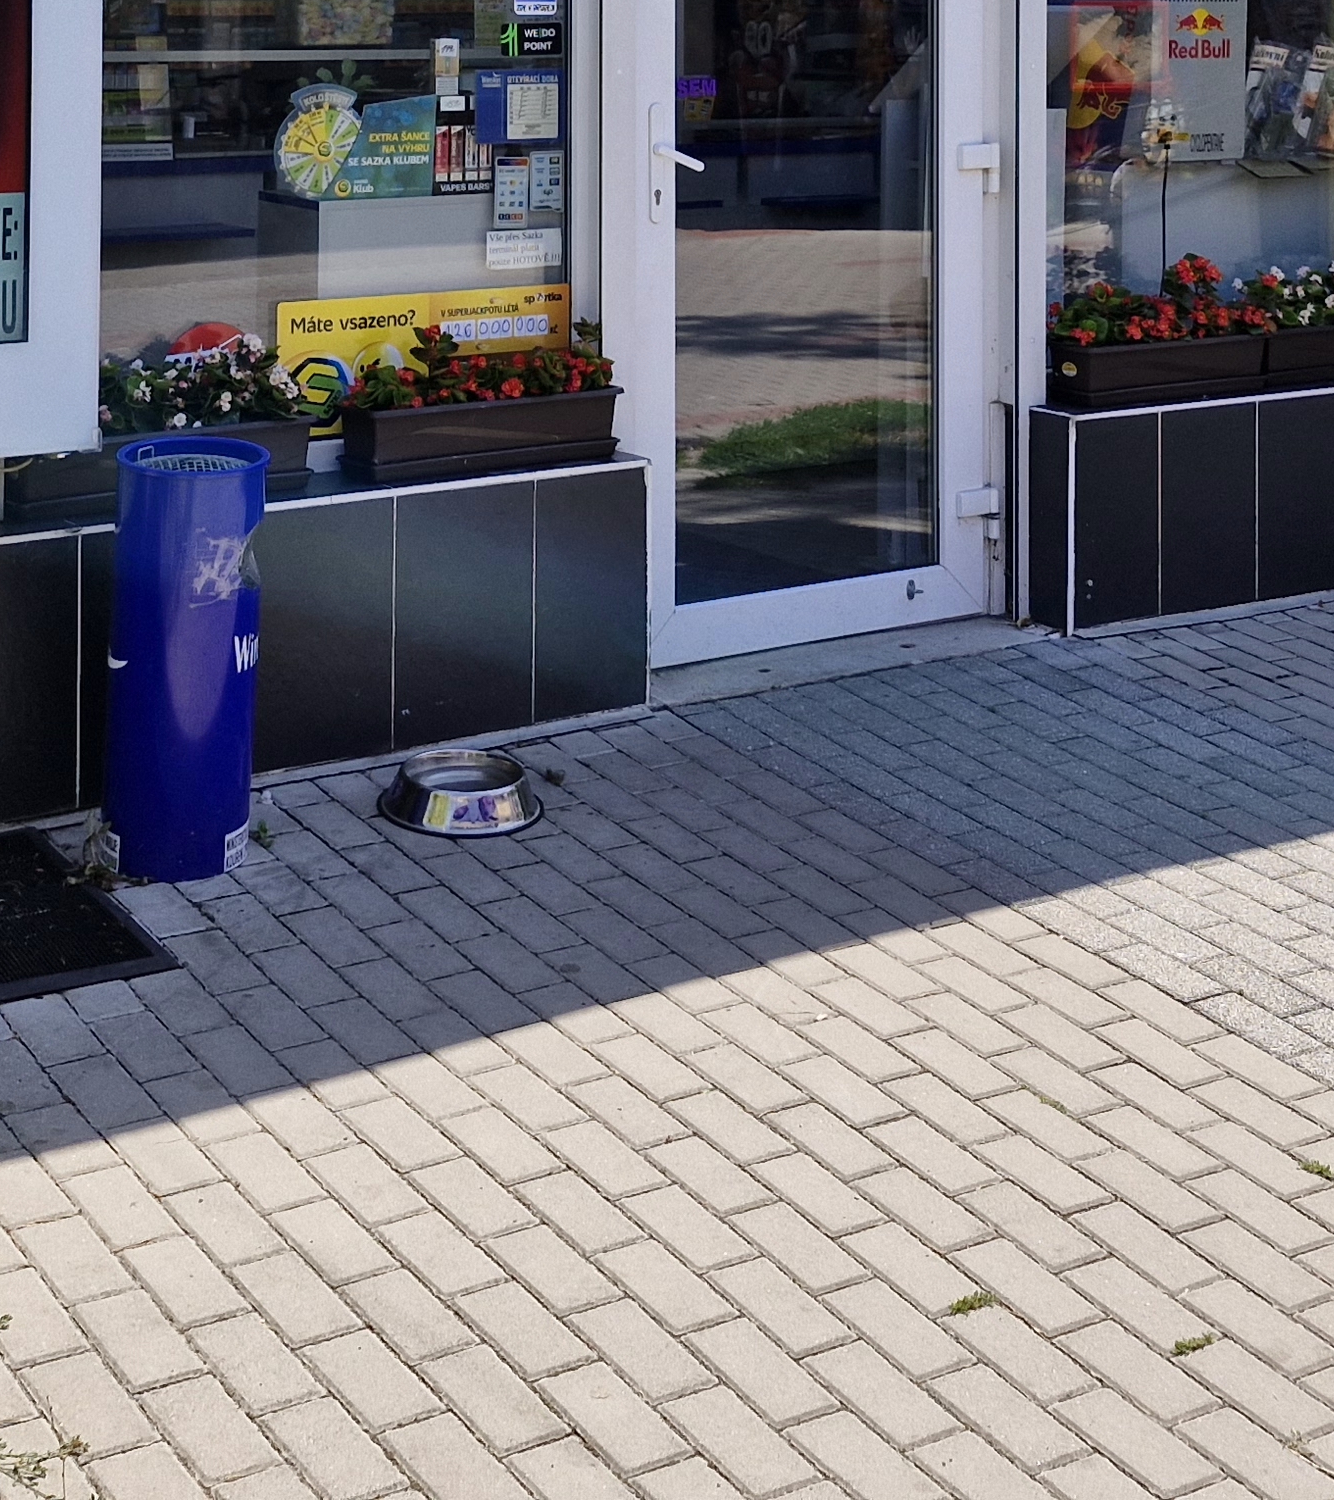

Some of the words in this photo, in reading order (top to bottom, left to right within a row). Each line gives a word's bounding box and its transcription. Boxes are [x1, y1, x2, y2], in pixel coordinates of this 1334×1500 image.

[523, 41, 553, 52] POINT
[1168, 39, 1200, 60] Red
[1201, 38, 1231, 59] Bull
[369, 132, 398, 143] EXTRA
[401, 130, 431, 142] ŠANCE
[382, 145, 396, 153] NA
[398, 142, 430, 153] VÝHRU
[348, 157, 359, 166] SE
[361, 156, 391, 166] SAZKA
[393, 154, 429, 166] KLUBEM
[353, 183, 374, 193] Klub
[290, 314, 334, 335] Máte
[340, 309, 417, 330] vsazeno?
